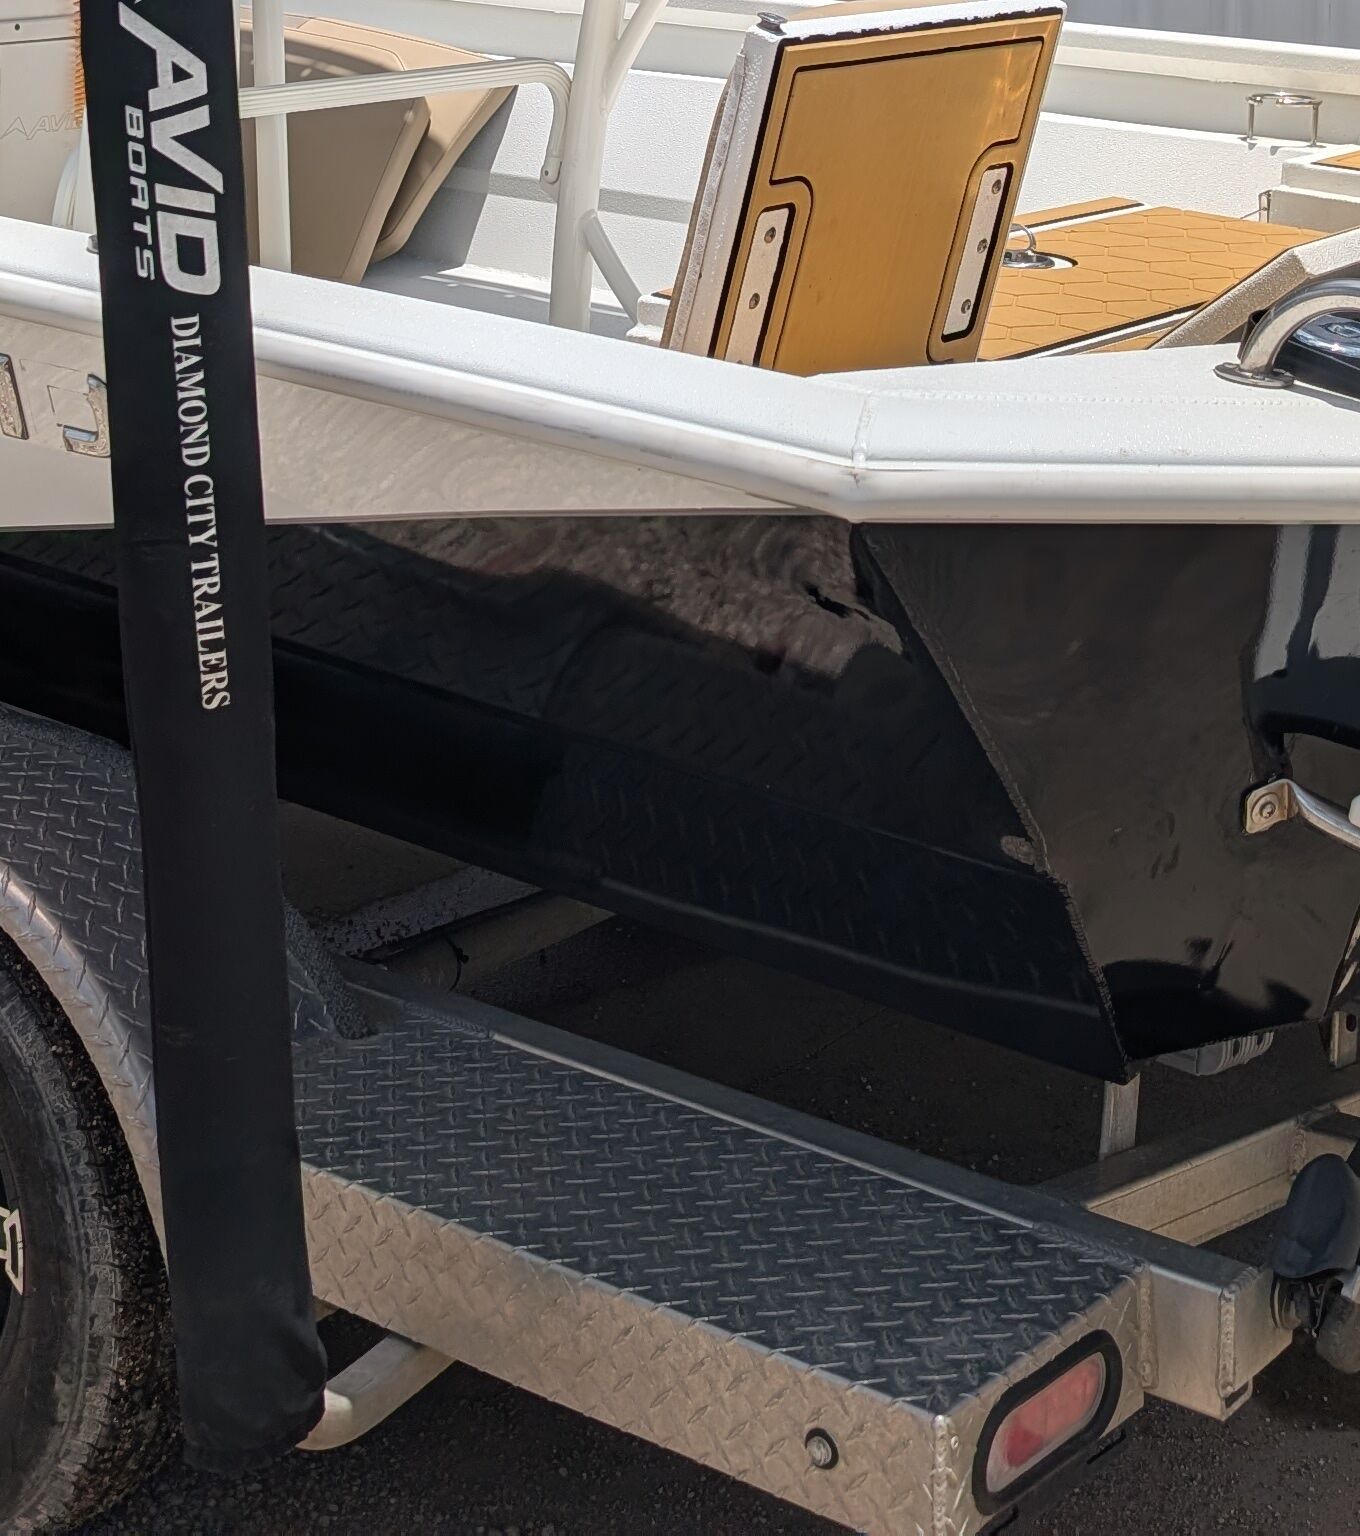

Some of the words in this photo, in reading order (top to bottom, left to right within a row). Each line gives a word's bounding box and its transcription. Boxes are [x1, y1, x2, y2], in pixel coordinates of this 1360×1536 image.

[117, 1, 225, 296] AVID
[124, 104, 156, 281] BOATS
[170, 313, 211, 467] DIAMOND
[183, 473, 218, 548] CITY
[190, 553, 232, 711] TRAILERS
